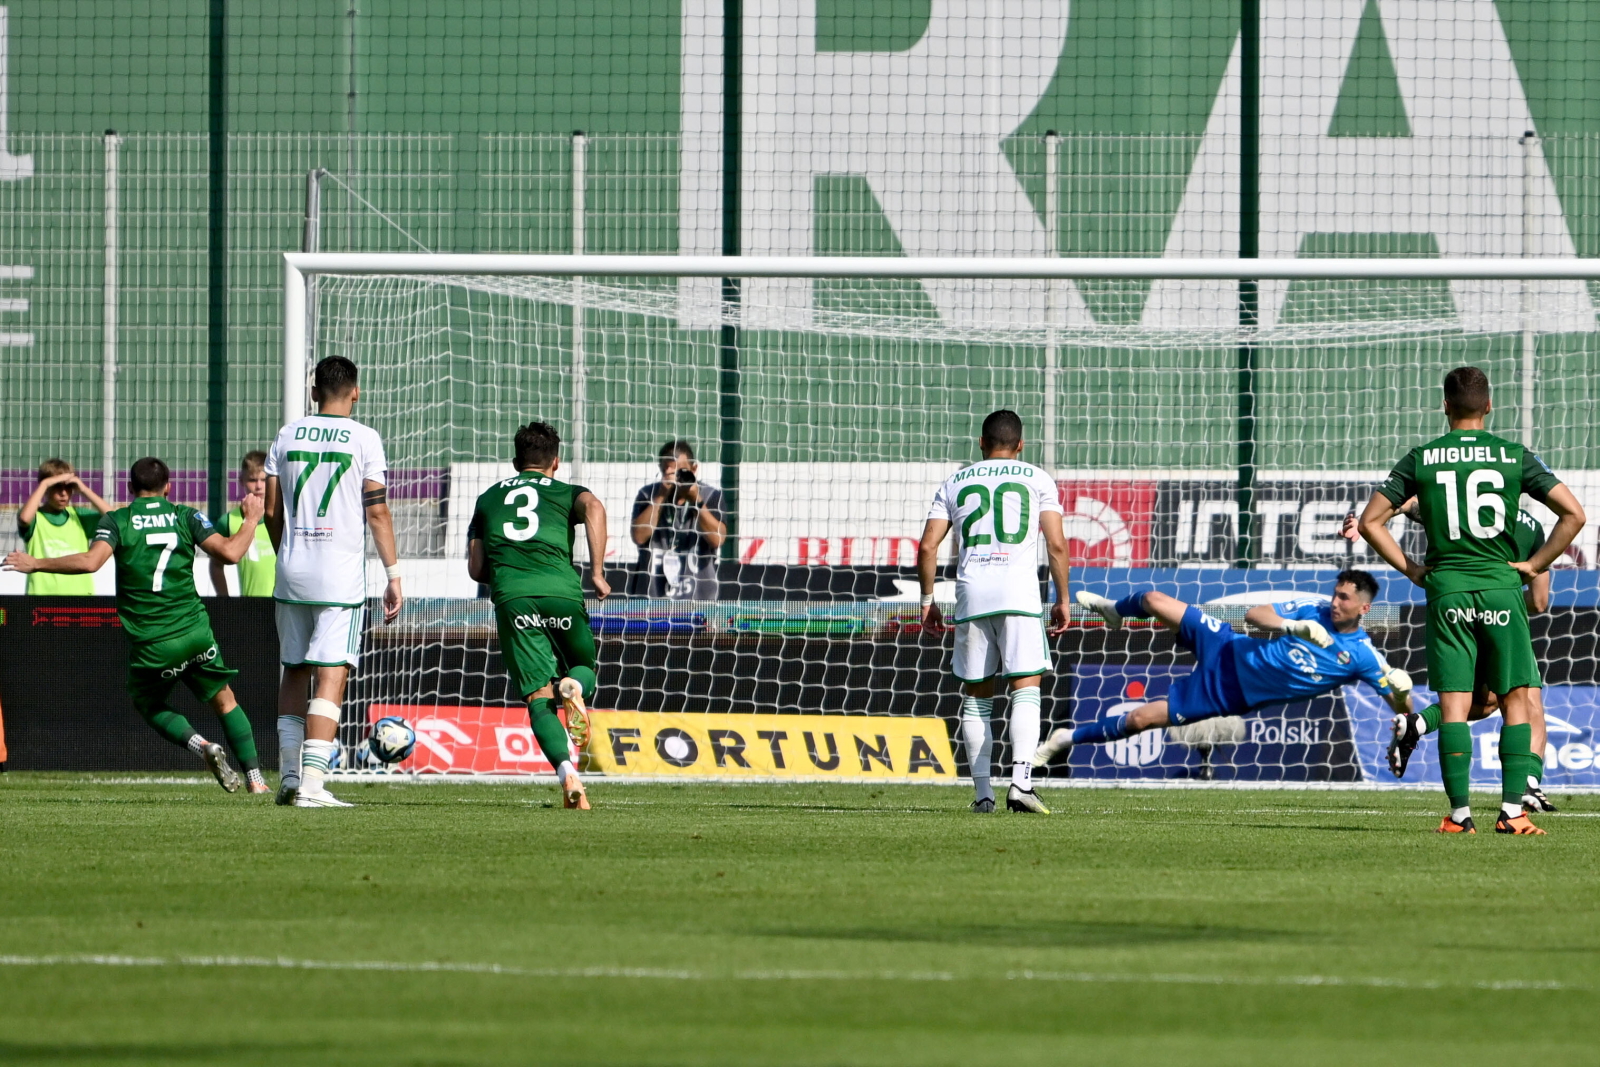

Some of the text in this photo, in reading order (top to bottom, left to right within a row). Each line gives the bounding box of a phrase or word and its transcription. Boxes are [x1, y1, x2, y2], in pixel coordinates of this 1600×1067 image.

[295, 427, 351, 443] DONIS
[1423, 447, 1517, 465] MIGUEL L.
[287, 450, 353, 517] 77
[953, 466, 1034, 483] MACHADO
[132, 512, 178, 530] SZMY
[503, 486, 539, 541] 3
[957, 482, 1029, 549] 20
[1436, 469, 1505, 540] 16
[146, 532, 178, 592] 7
[607, 727, 947, 774] FORTUNA
[1251, 720, 1320, 744] Polski
